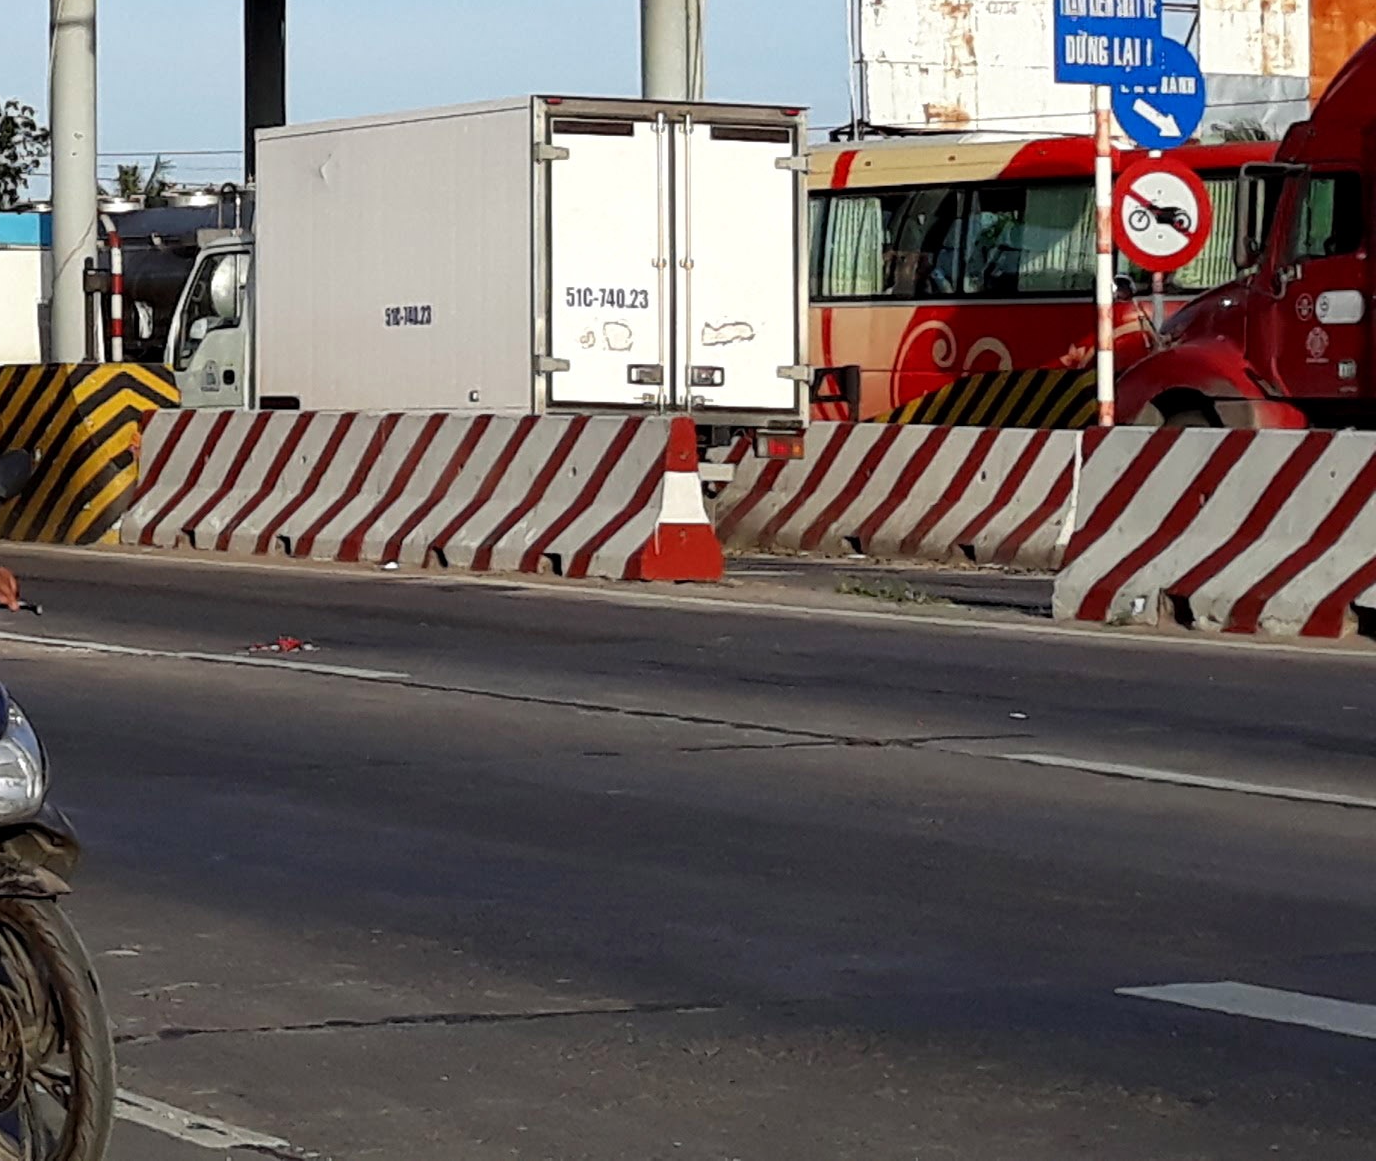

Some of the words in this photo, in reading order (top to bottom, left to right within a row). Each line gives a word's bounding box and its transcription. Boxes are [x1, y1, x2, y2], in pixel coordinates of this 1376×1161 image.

[1064, 29, 1109, 66] DỪNG
[1113, 37, 1142, 73] LẠI
[565, 287, 649, 309] 51C-740.23
